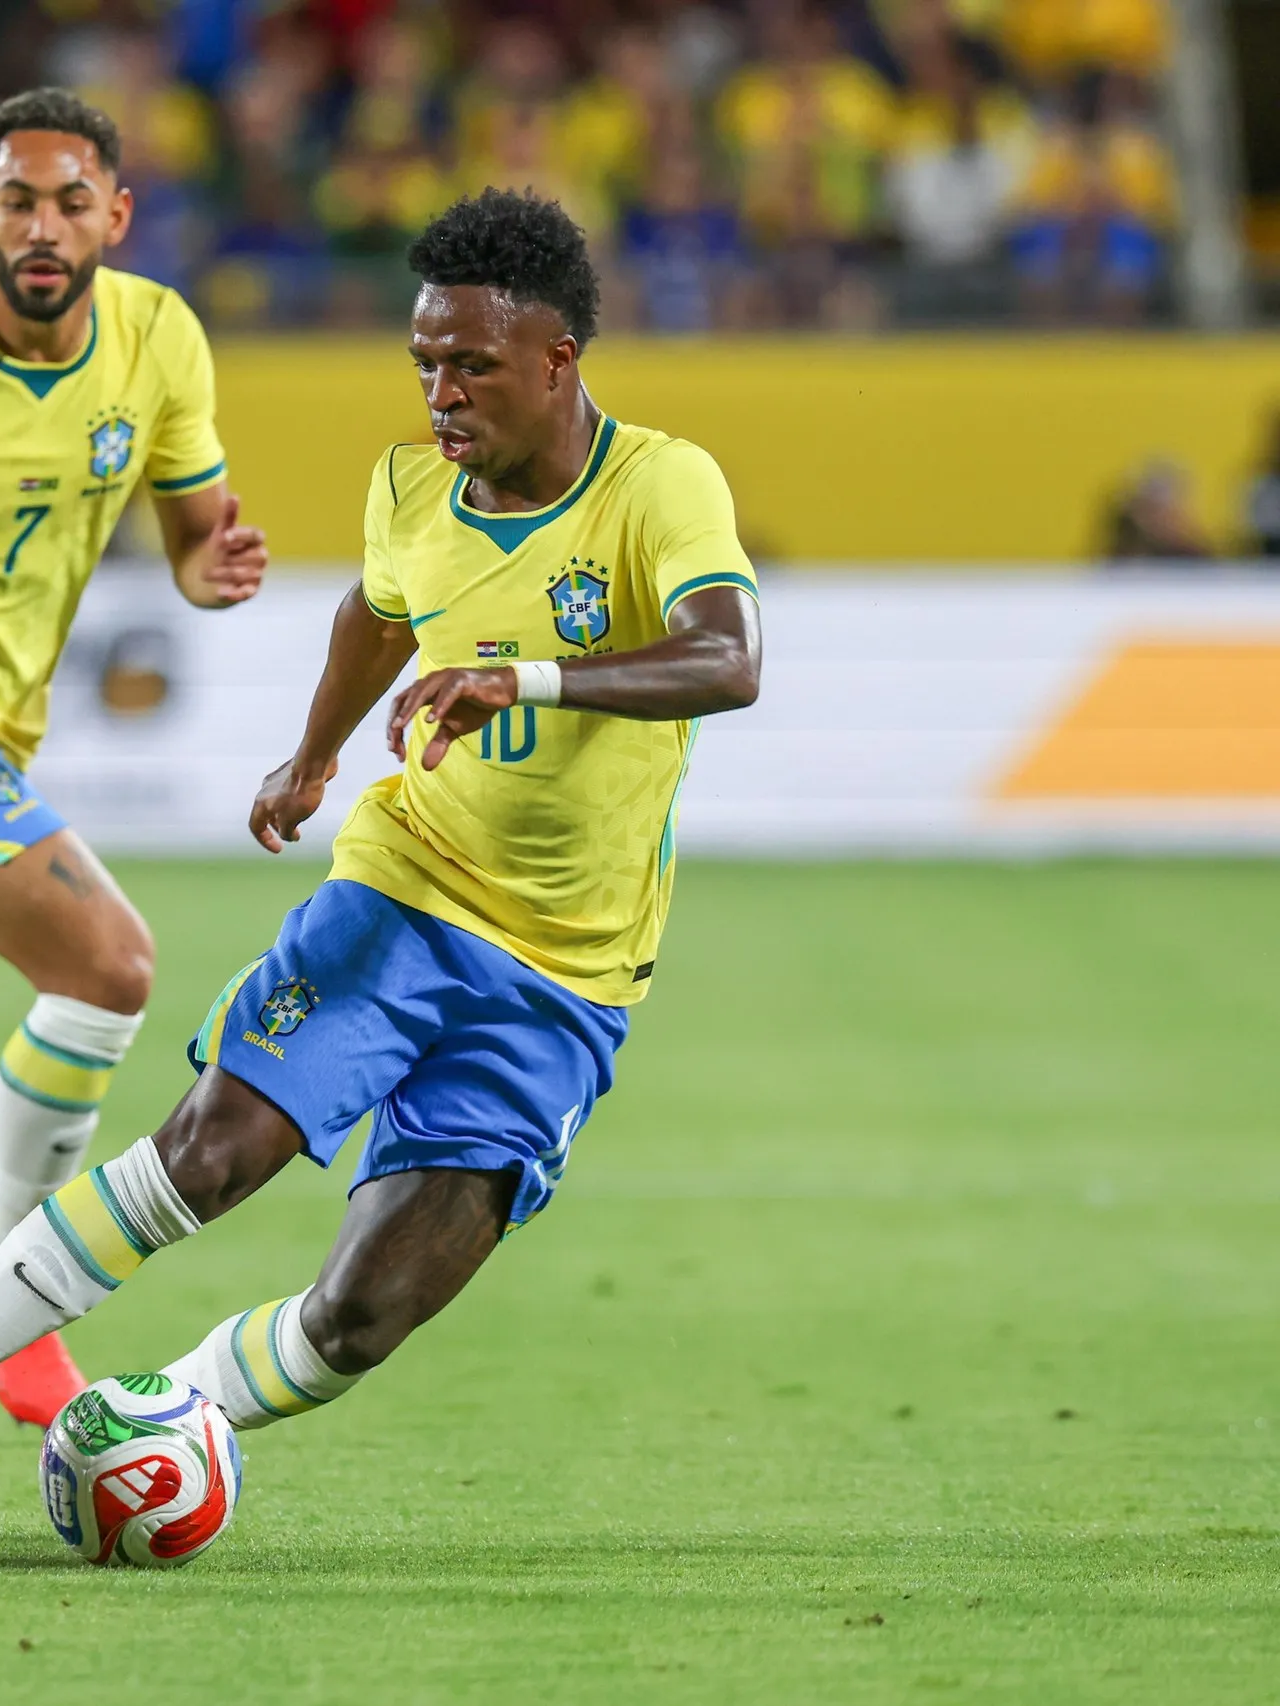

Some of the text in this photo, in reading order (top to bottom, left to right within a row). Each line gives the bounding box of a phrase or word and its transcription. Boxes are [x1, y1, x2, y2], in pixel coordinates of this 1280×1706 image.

[4, 505, 51, 574] 7
[568, 601, 591, 614] CBF
[276, 1002, 295, 1014] CBF
[242, 1030, 285, 1061] BRASIL
